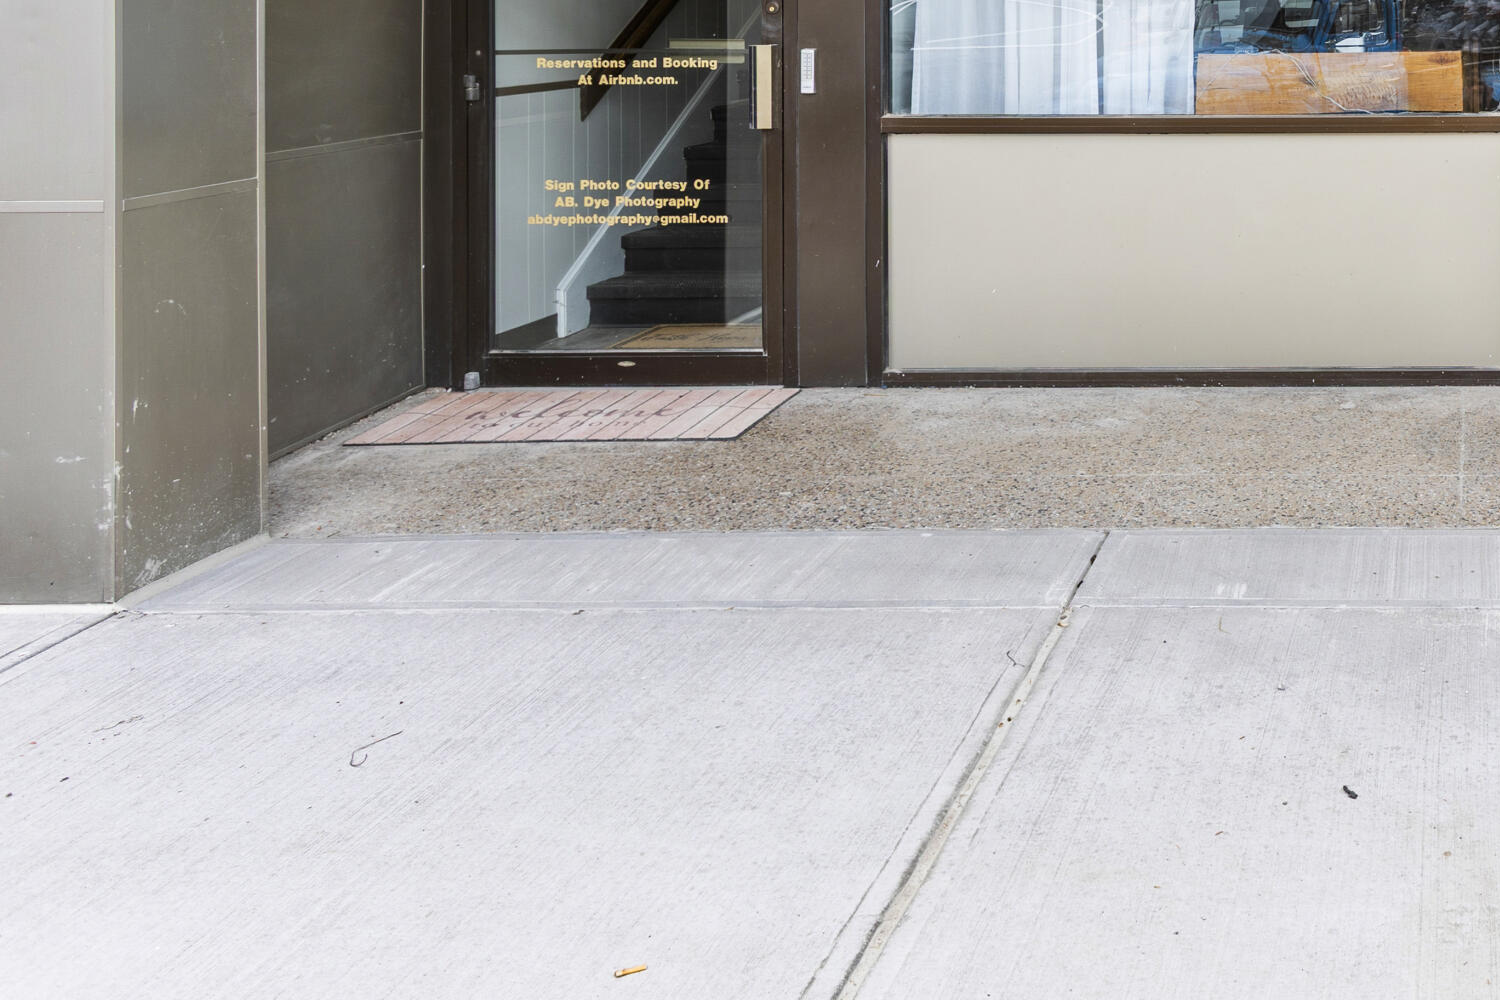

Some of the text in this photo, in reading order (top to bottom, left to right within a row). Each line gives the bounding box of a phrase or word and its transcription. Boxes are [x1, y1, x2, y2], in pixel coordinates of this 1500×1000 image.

[536, 57, 718, 70] Reservations and Booking
[578, 74, 678, 86] At Airbnb.com.
[544, 178, 710, 193] Sign Photo Courtesy Of
[554, 196, 700, 210] AB. Dye Photography
[527, 213, 729, 226] abdyephotography@gmail.com
